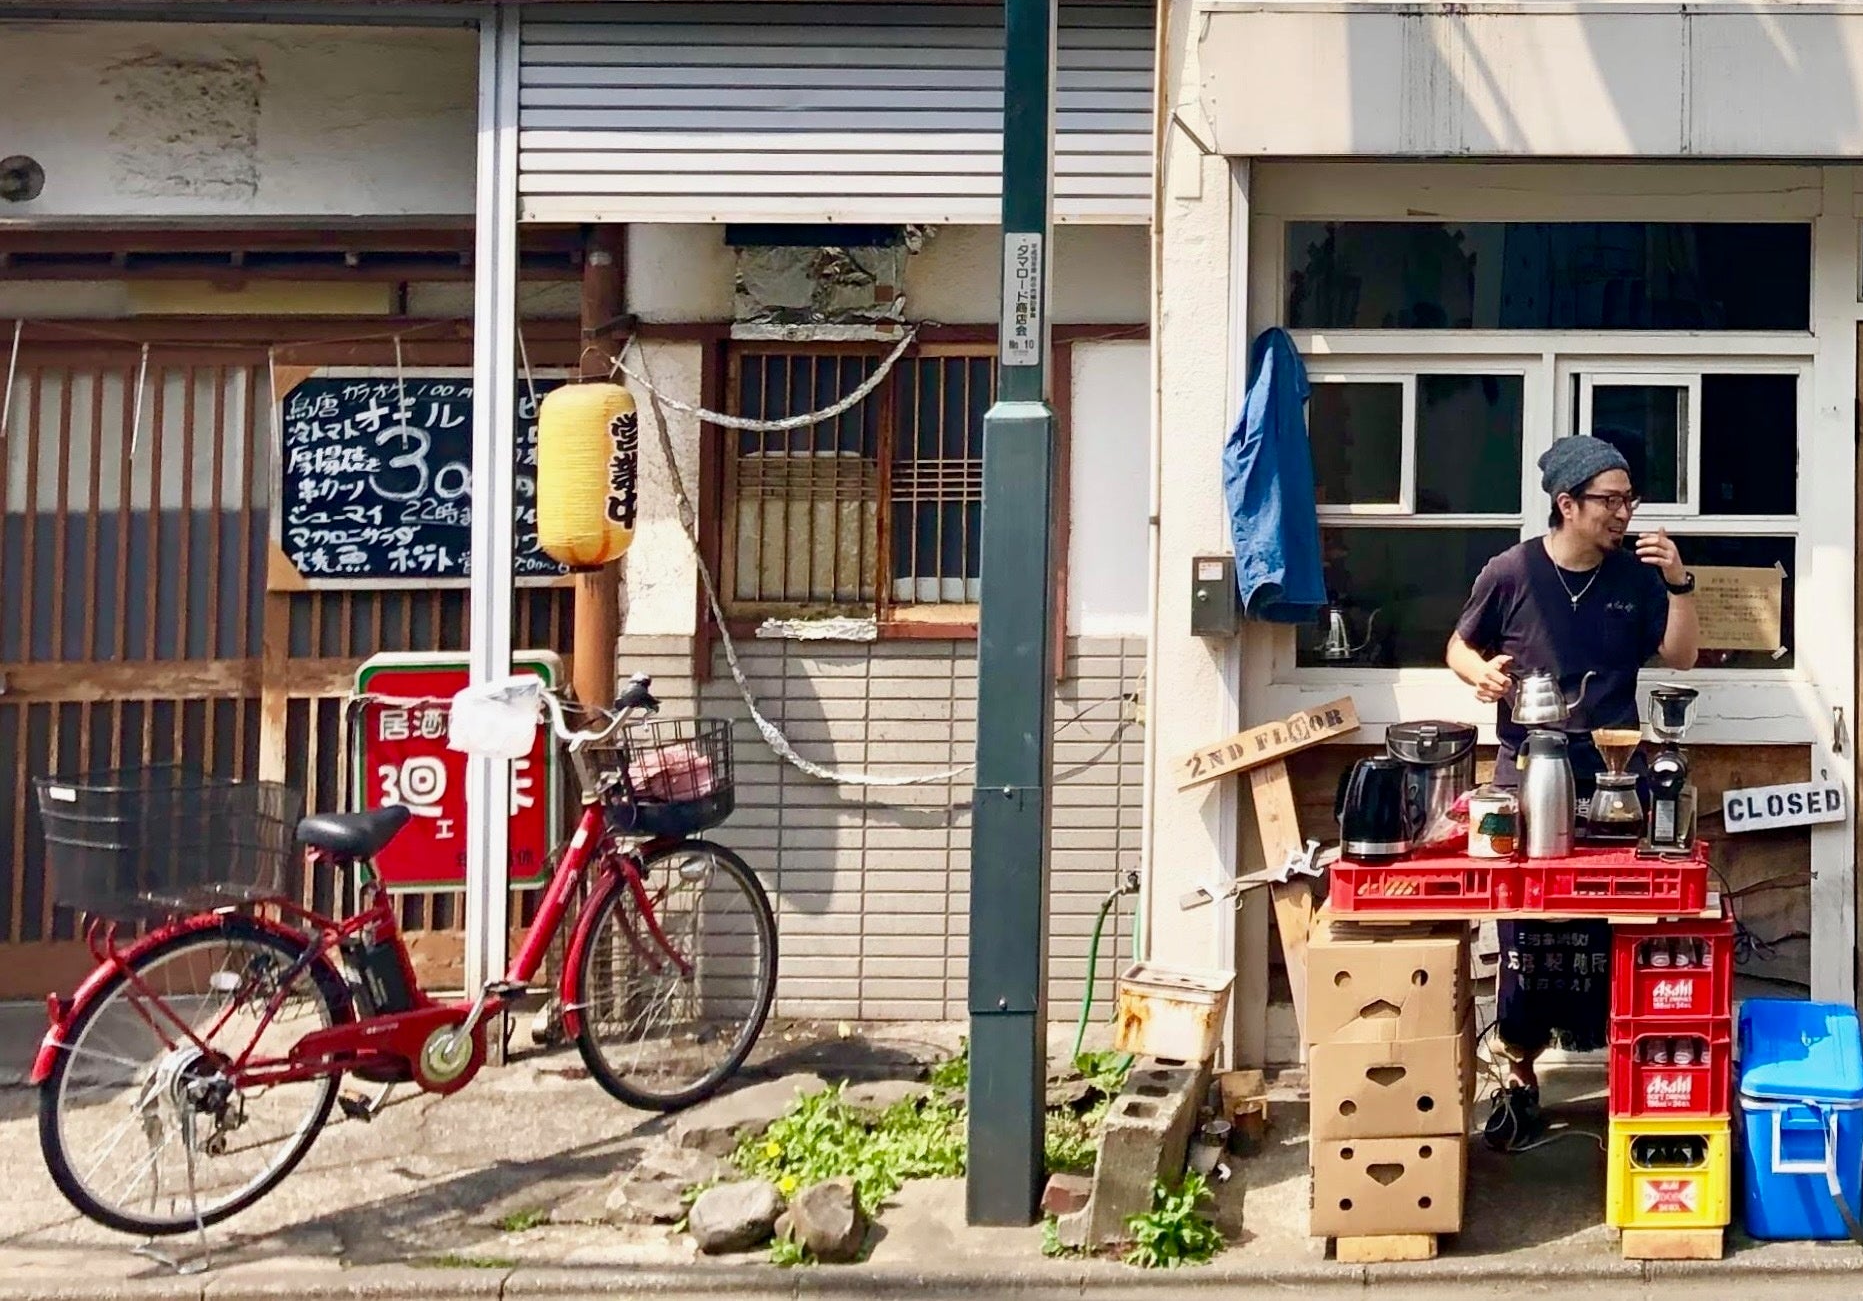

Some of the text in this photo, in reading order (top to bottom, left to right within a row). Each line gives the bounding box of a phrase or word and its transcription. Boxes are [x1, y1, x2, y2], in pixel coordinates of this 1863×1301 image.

[1015, 244, 1029, 337] タマロード商店会
[1024, 339, 1035, 349] 10
[288, 526, 421, 548] マカロニサラダ
[1185, 709, 1344, 779] 2ND FLOOR
[1727, 786, 1843, 823] CLOSED
[1653, 979, 1693, 997] Asahi
[1646, 1074, 1692, 1094] Asahi
